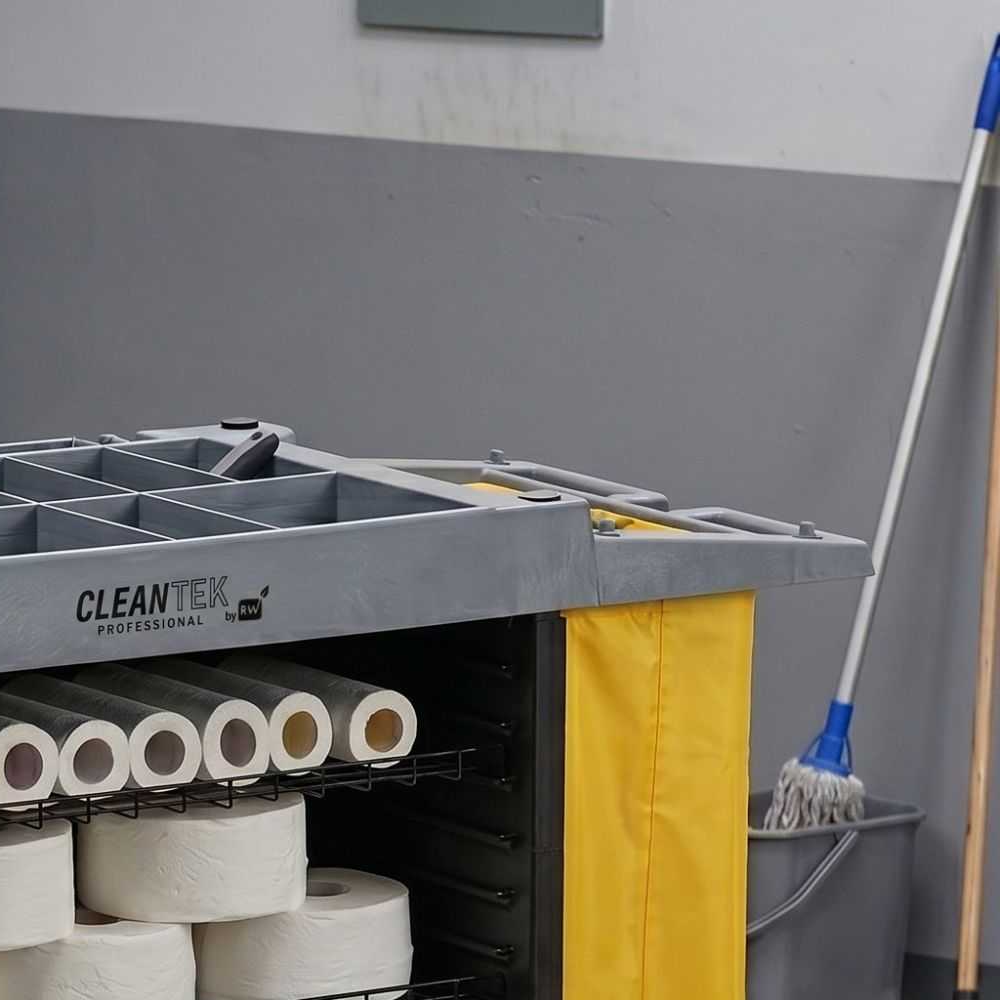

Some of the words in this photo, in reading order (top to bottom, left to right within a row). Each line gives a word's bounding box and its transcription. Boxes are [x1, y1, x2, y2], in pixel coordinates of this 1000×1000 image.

[76, 576, 229, 622] CLEANTEK
[225, 611, 236, 623] by
[240, 601, 261, 616] RW
[98, 616, 204, 635] PROFESSIONAL
